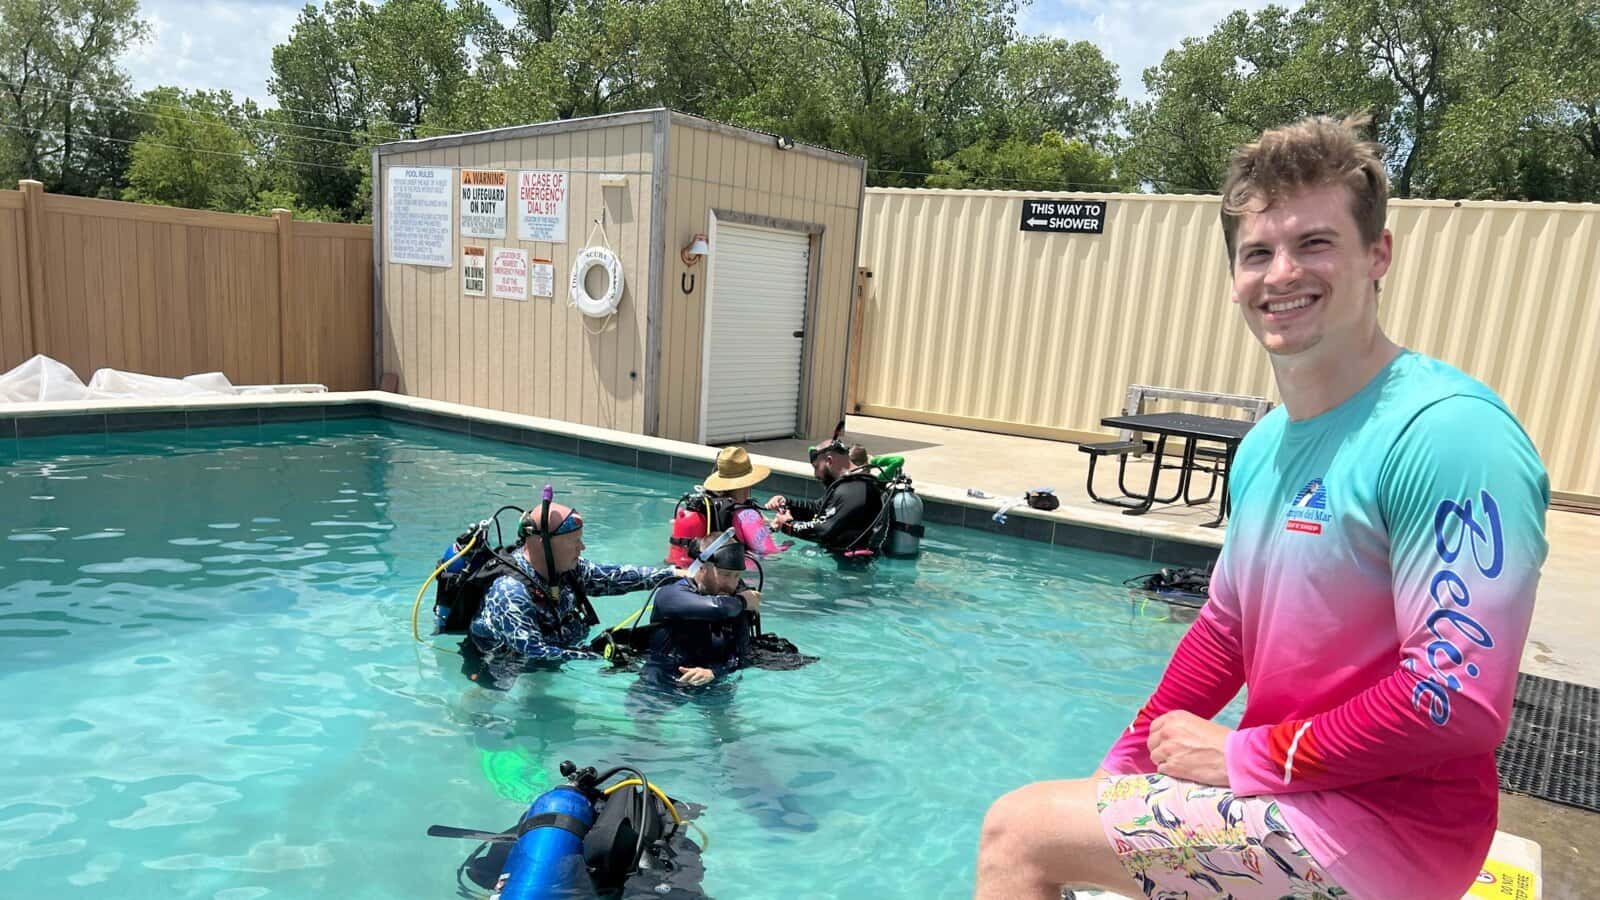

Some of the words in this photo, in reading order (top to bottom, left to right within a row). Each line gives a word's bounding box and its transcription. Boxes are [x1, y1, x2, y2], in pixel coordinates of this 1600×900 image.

[405, 169, 417, 178] POOL
[473, 171, 504, 185] WARNING
[523, 173, 530, 187] IN
[531, 173, 551, 188] CASE
[552, 174, 564, 188] OF
[462, 187, 471, 201] NO
[472, 188, 505, 202] LIFEGUARD
[520, 186, 565, 202] EMERGENCY
[470, 200, 479, 214] ON
[480, 201, 497, 215] DUTY
[527, 201, 543, 215] DIAL
[545, 202, 557, 216] 911
[1030, 203, 1055, 215] THIS
[1057, 204, 1082, 216] WAY
[1085, 205, 1100, 216] TO
[1048, 217, 1098, 230] SHOWER
[464, 266, 471, 278] NO
[471, 267, 484, 279] DIVING
[1314, 510, 1333, 522] Mar
[1404, 488, 1504, 726] Belie
[1502, 873, 1514, 885] NOT
[1500, 884, 1513, 896] DO
